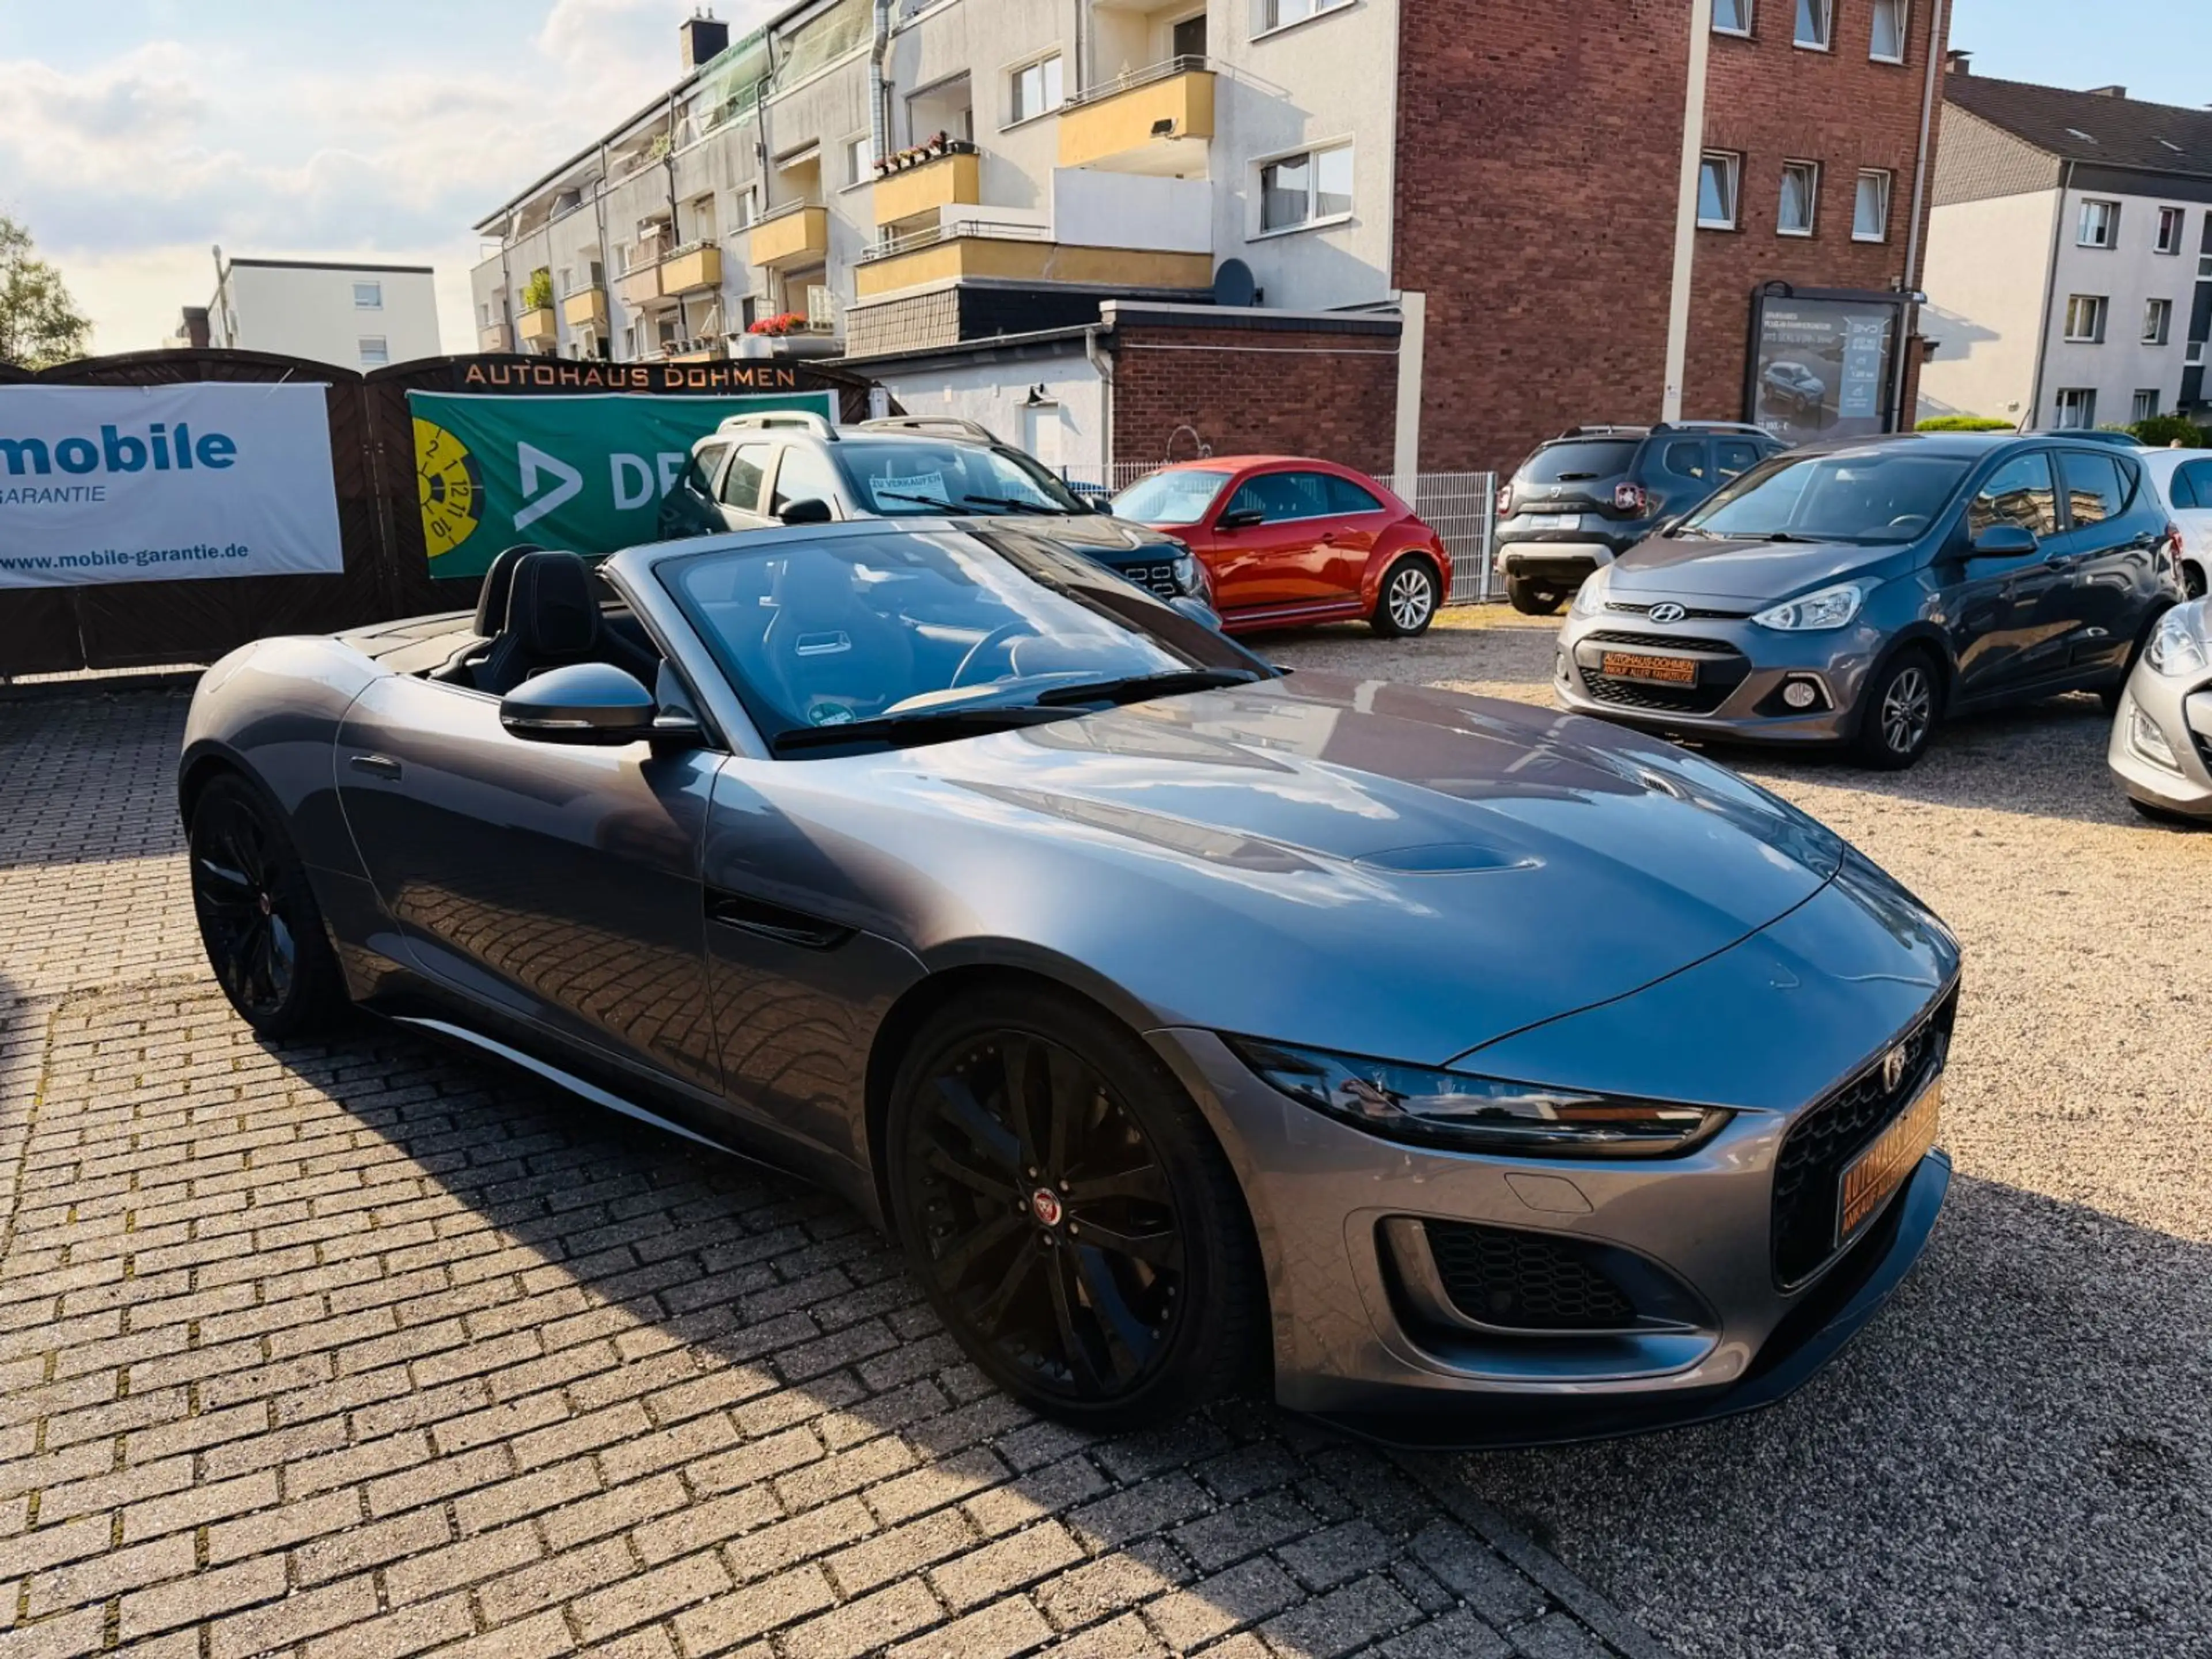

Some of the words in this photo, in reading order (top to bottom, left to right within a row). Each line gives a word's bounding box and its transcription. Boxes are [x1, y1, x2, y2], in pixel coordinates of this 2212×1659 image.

[465, 364, 650, 387] AUTOHAUS
[664, 368, 796, 388] DOHMEN
[0, 423, 237, 475] mobile
[425, 439, 440, 459] 2
[0, 486, 107, 504] ARANTIE
[450, 479, 469, 498] 12
[446, 501, 467, 519] 11
[430, 517, 452, 538] 10
[0, 543, 249, 569] www.mobile-garantie.de
